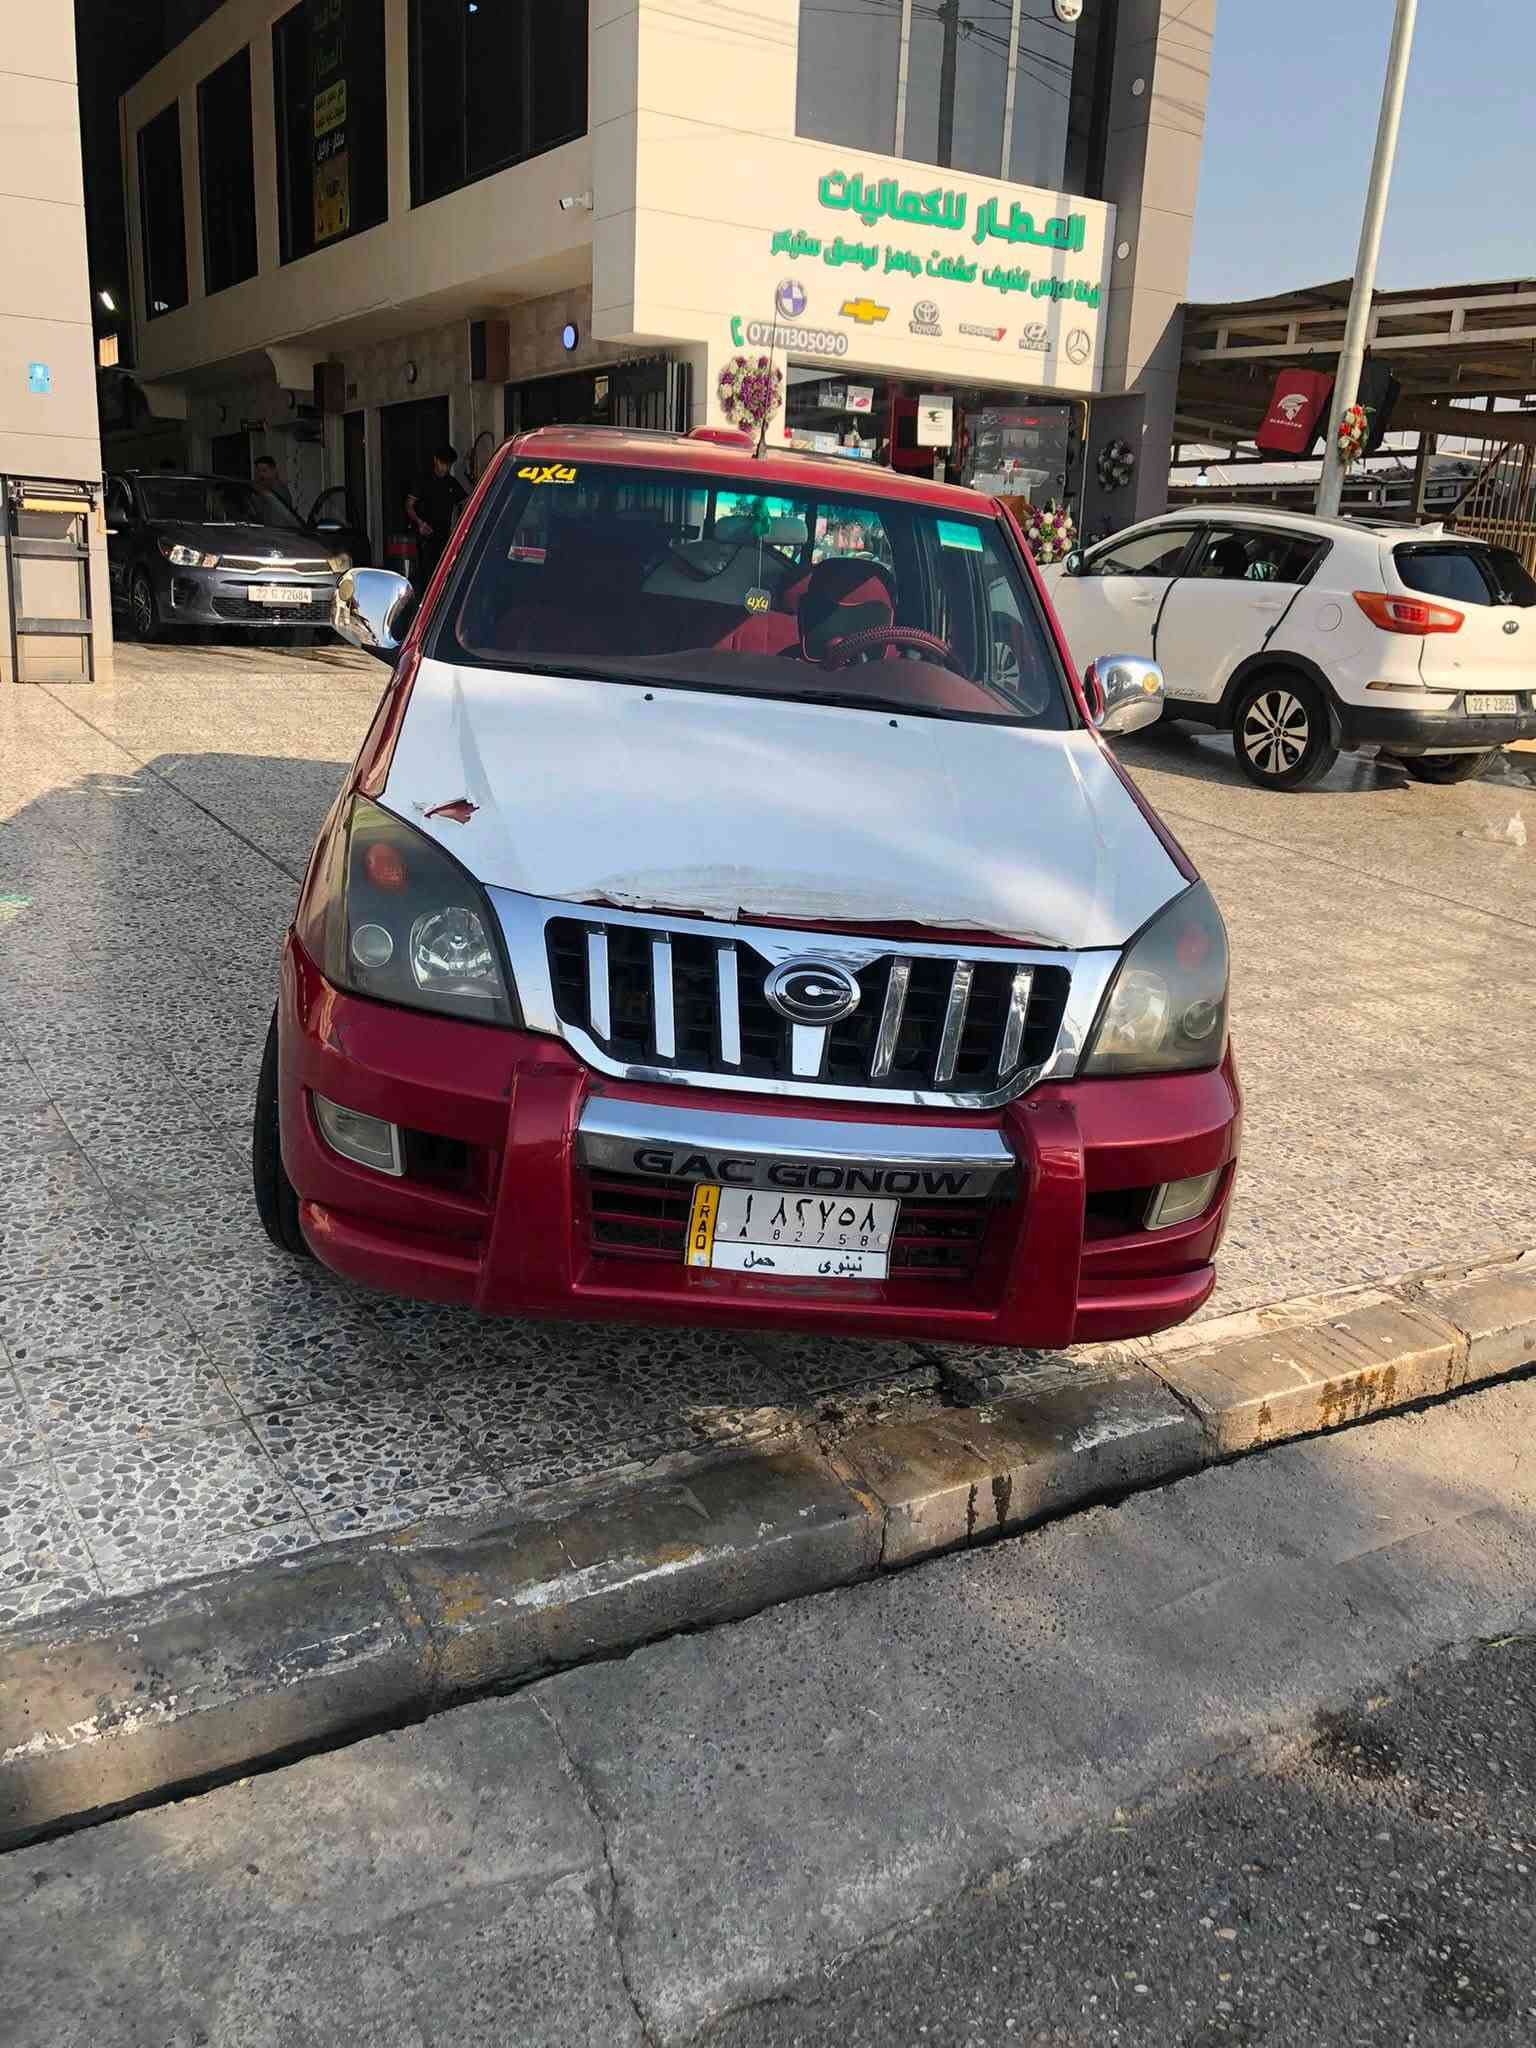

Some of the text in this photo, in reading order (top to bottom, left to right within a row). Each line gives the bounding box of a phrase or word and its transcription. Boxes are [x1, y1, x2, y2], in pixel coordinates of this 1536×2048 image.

[818, 169, 1086, 252] العطار للكماليات
[633, 1148, 972, 1196] GAC GONOW
